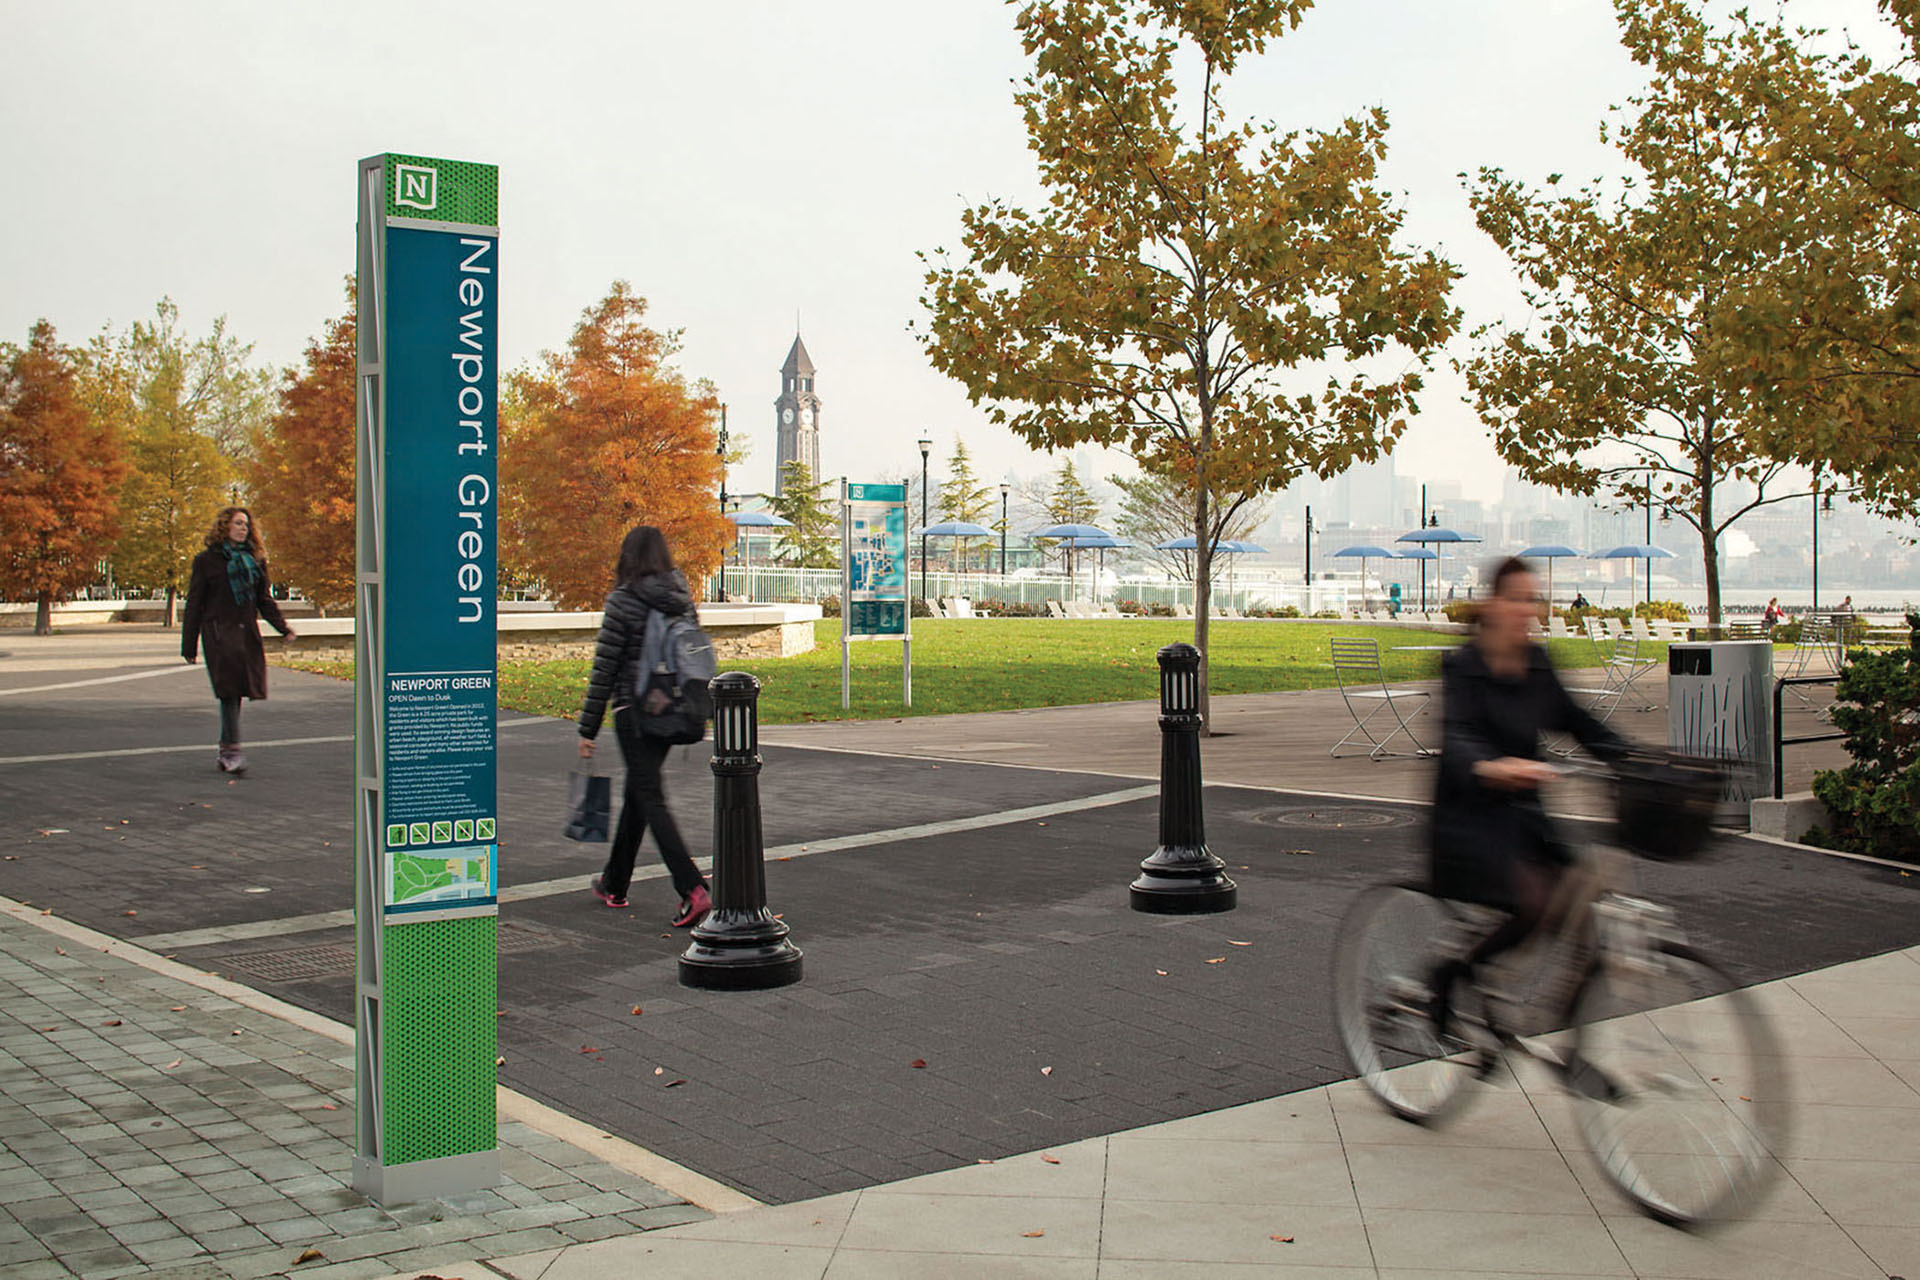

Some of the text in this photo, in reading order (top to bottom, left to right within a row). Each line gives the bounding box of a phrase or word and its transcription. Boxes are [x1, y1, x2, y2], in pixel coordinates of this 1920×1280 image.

[406, 174, 428, 200] N
[452, 238, 491, 623] Newport Green
[391, 677, 490, 691] NEWPORT GREEN
